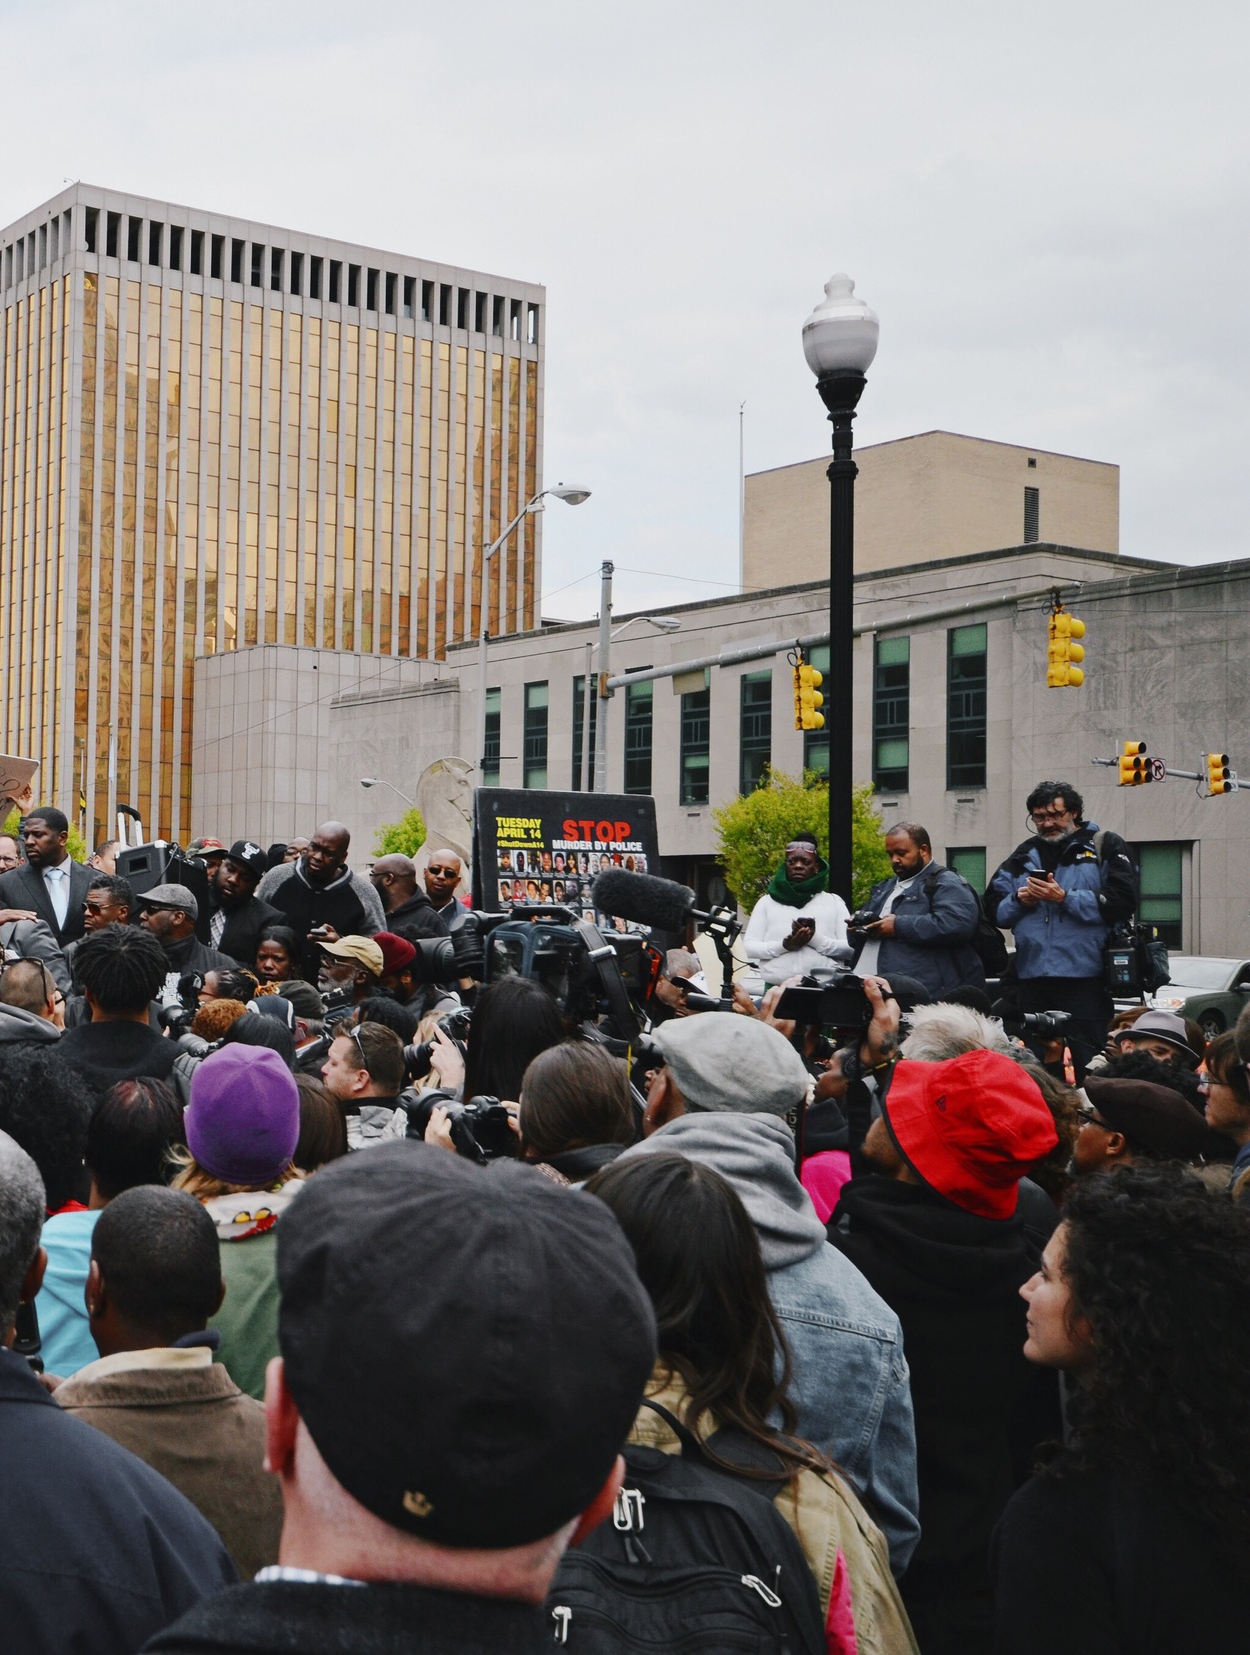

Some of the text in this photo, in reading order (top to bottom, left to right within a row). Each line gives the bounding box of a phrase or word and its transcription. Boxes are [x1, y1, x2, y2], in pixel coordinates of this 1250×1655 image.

[495, 817, 542, 829] TUESDAY
[496, 828, 541, 839] APRIL 14
[562, 819, 632, 842] STOP
[552, 840, 642, 851] MURDER BY POLICE
